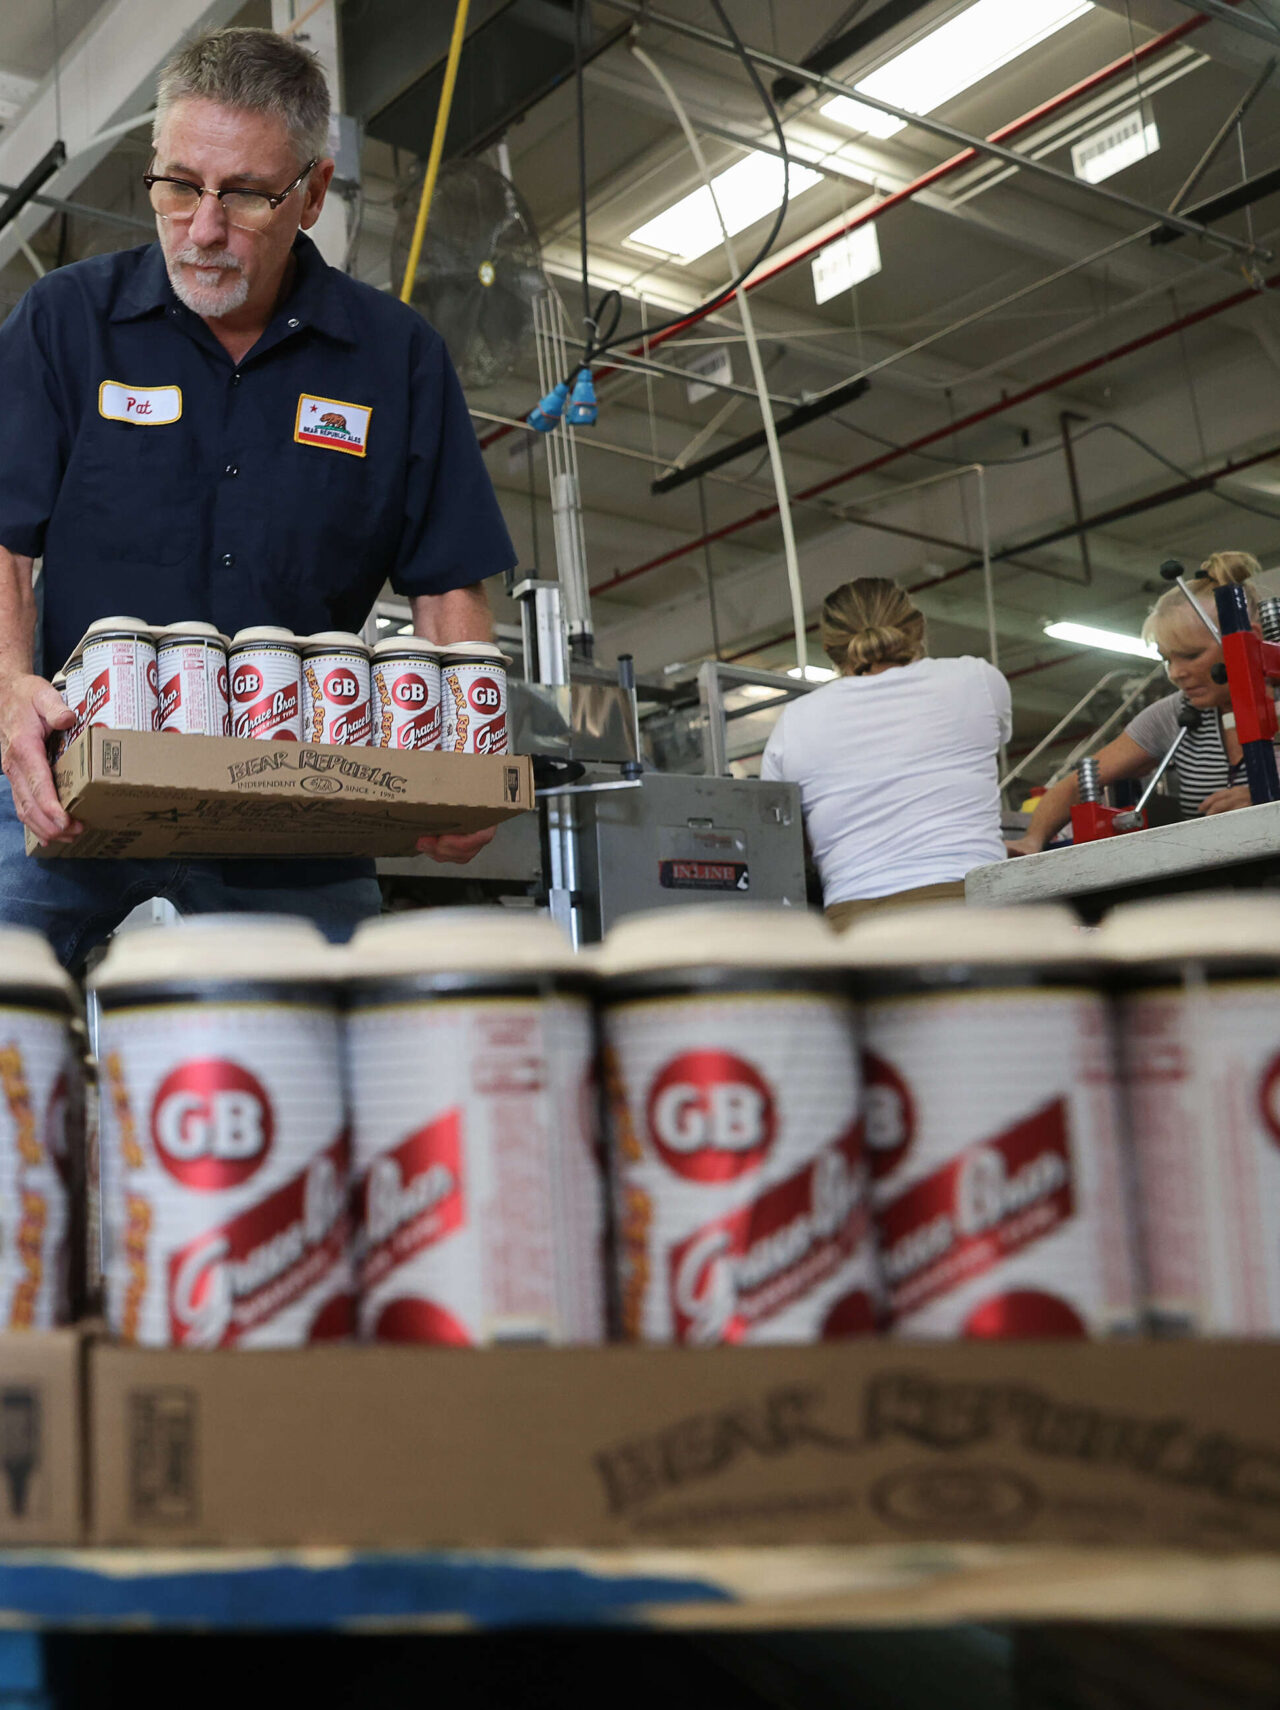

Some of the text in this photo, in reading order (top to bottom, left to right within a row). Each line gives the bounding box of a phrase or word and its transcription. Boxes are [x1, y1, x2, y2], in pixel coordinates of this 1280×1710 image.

[126, 396, 153, 415] Pat
[303, 426, 362, 444] BEAR REPUBLIC ALES
[234, 674, 260, 695] GB
[305, 665, 323, 708] BEAR
[327, 678, 357, 697] GB
[373, 671, 391, 711] BEAR
[395, 683, 426, 701] GB
[446, 673, 468, 713] BEAR
[471, 687, 499, 706] GB
[236, 706, 272, 740] Grace
[282, 709, 295, 720] TYPE
[333, 716, 367, 745] Grace
[401, 722, 435, 750] Grace
[227, 751, 299, 784] BEAR
[237, 780, 297, 790] INDEPENDENT
[344, 785, 369, 795] SINCE
[156, 1090, 266, 1160] GB
[654, 1082, 767, 1153] GB
